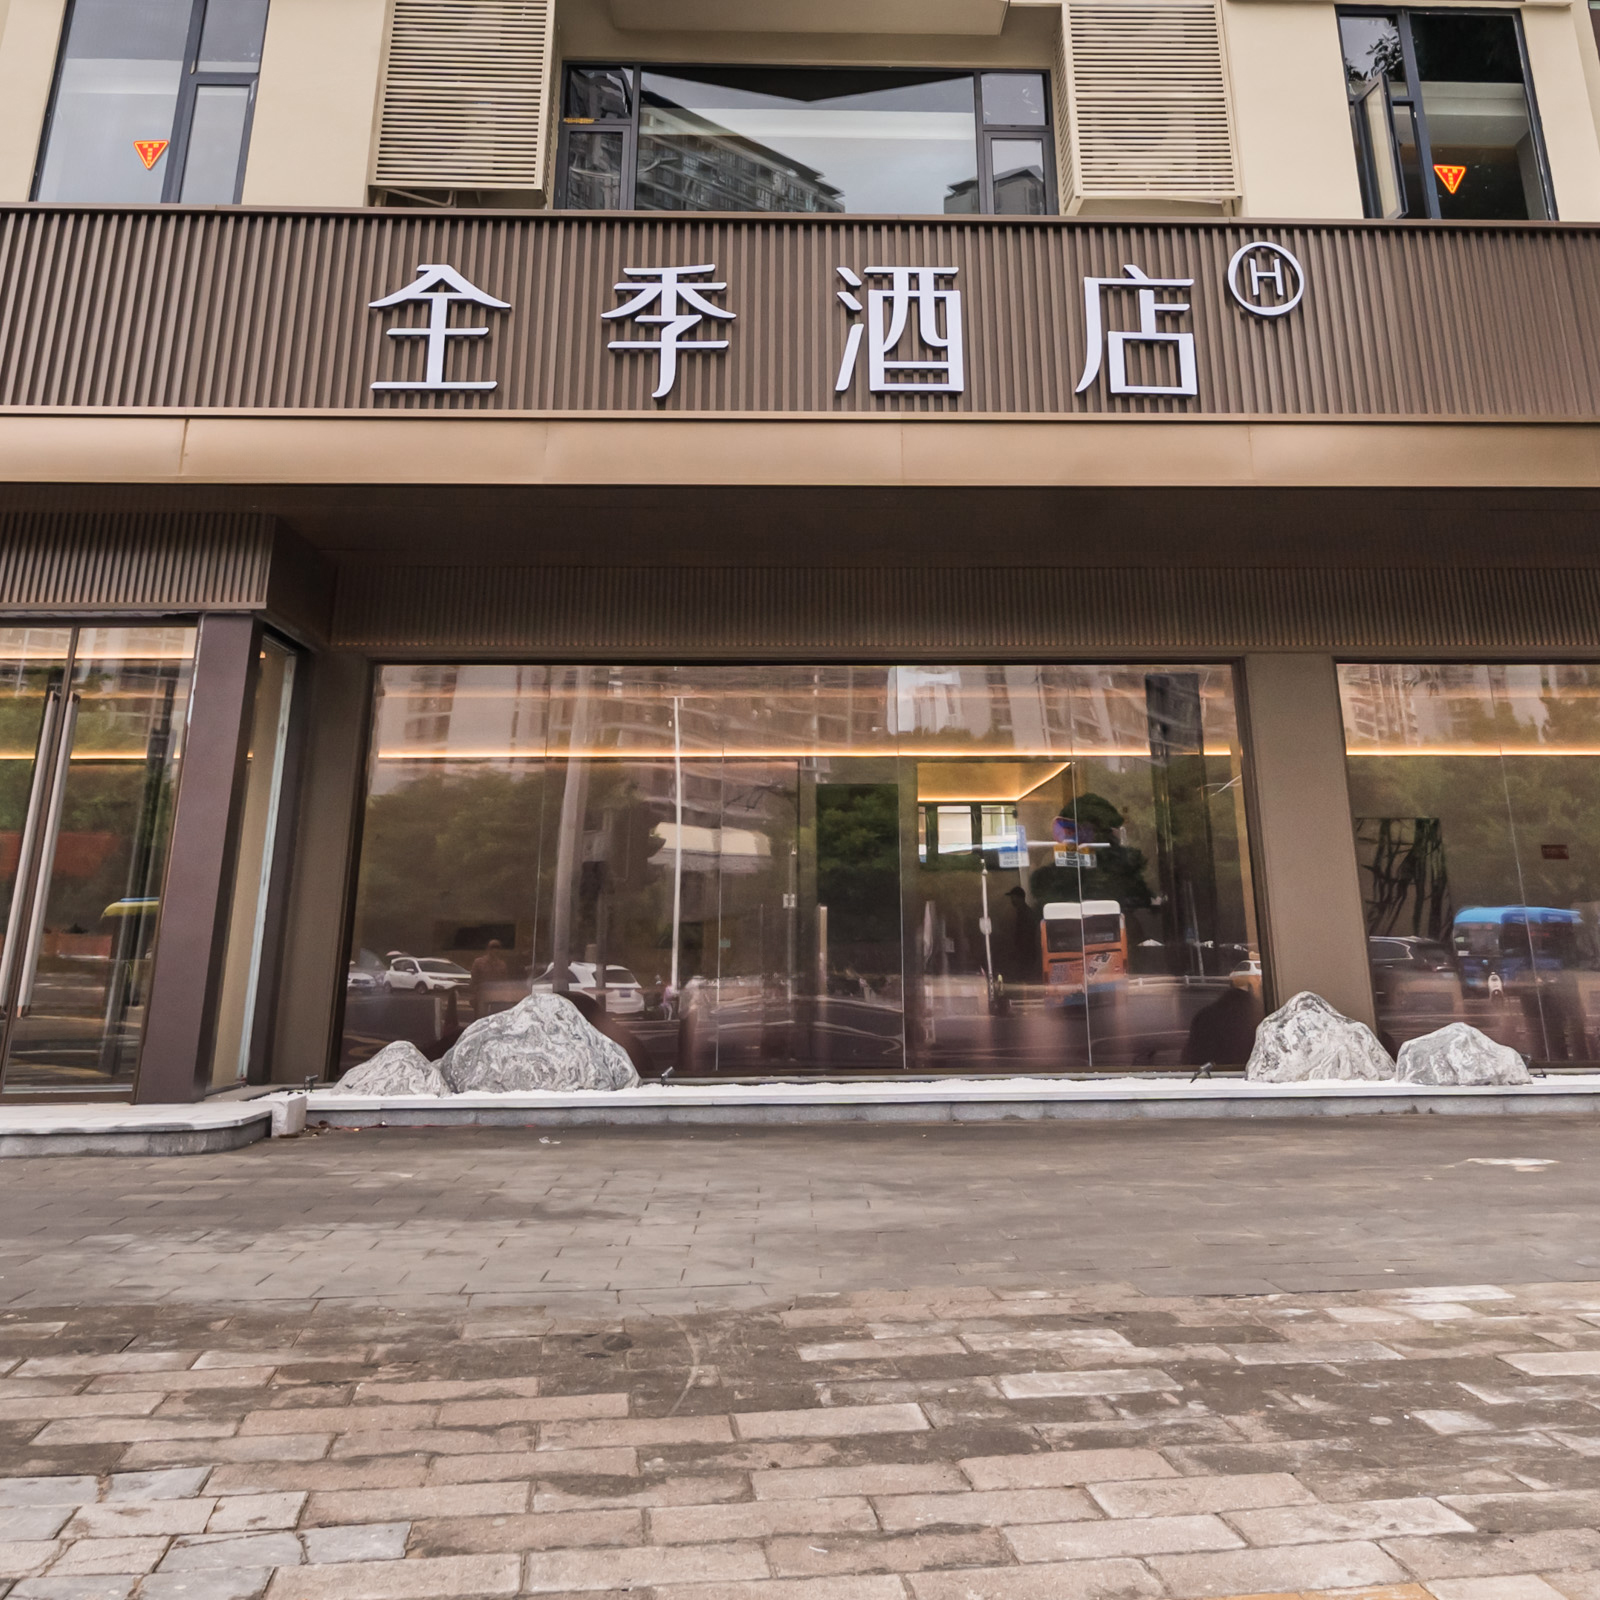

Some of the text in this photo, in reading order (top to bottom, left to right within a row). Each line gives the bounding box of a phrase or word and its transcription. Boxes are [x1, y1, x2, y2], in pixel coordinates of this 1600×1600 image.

[1249, 258, 1284, 296] H
[367, 263, 1198, 398] 全季酒店
